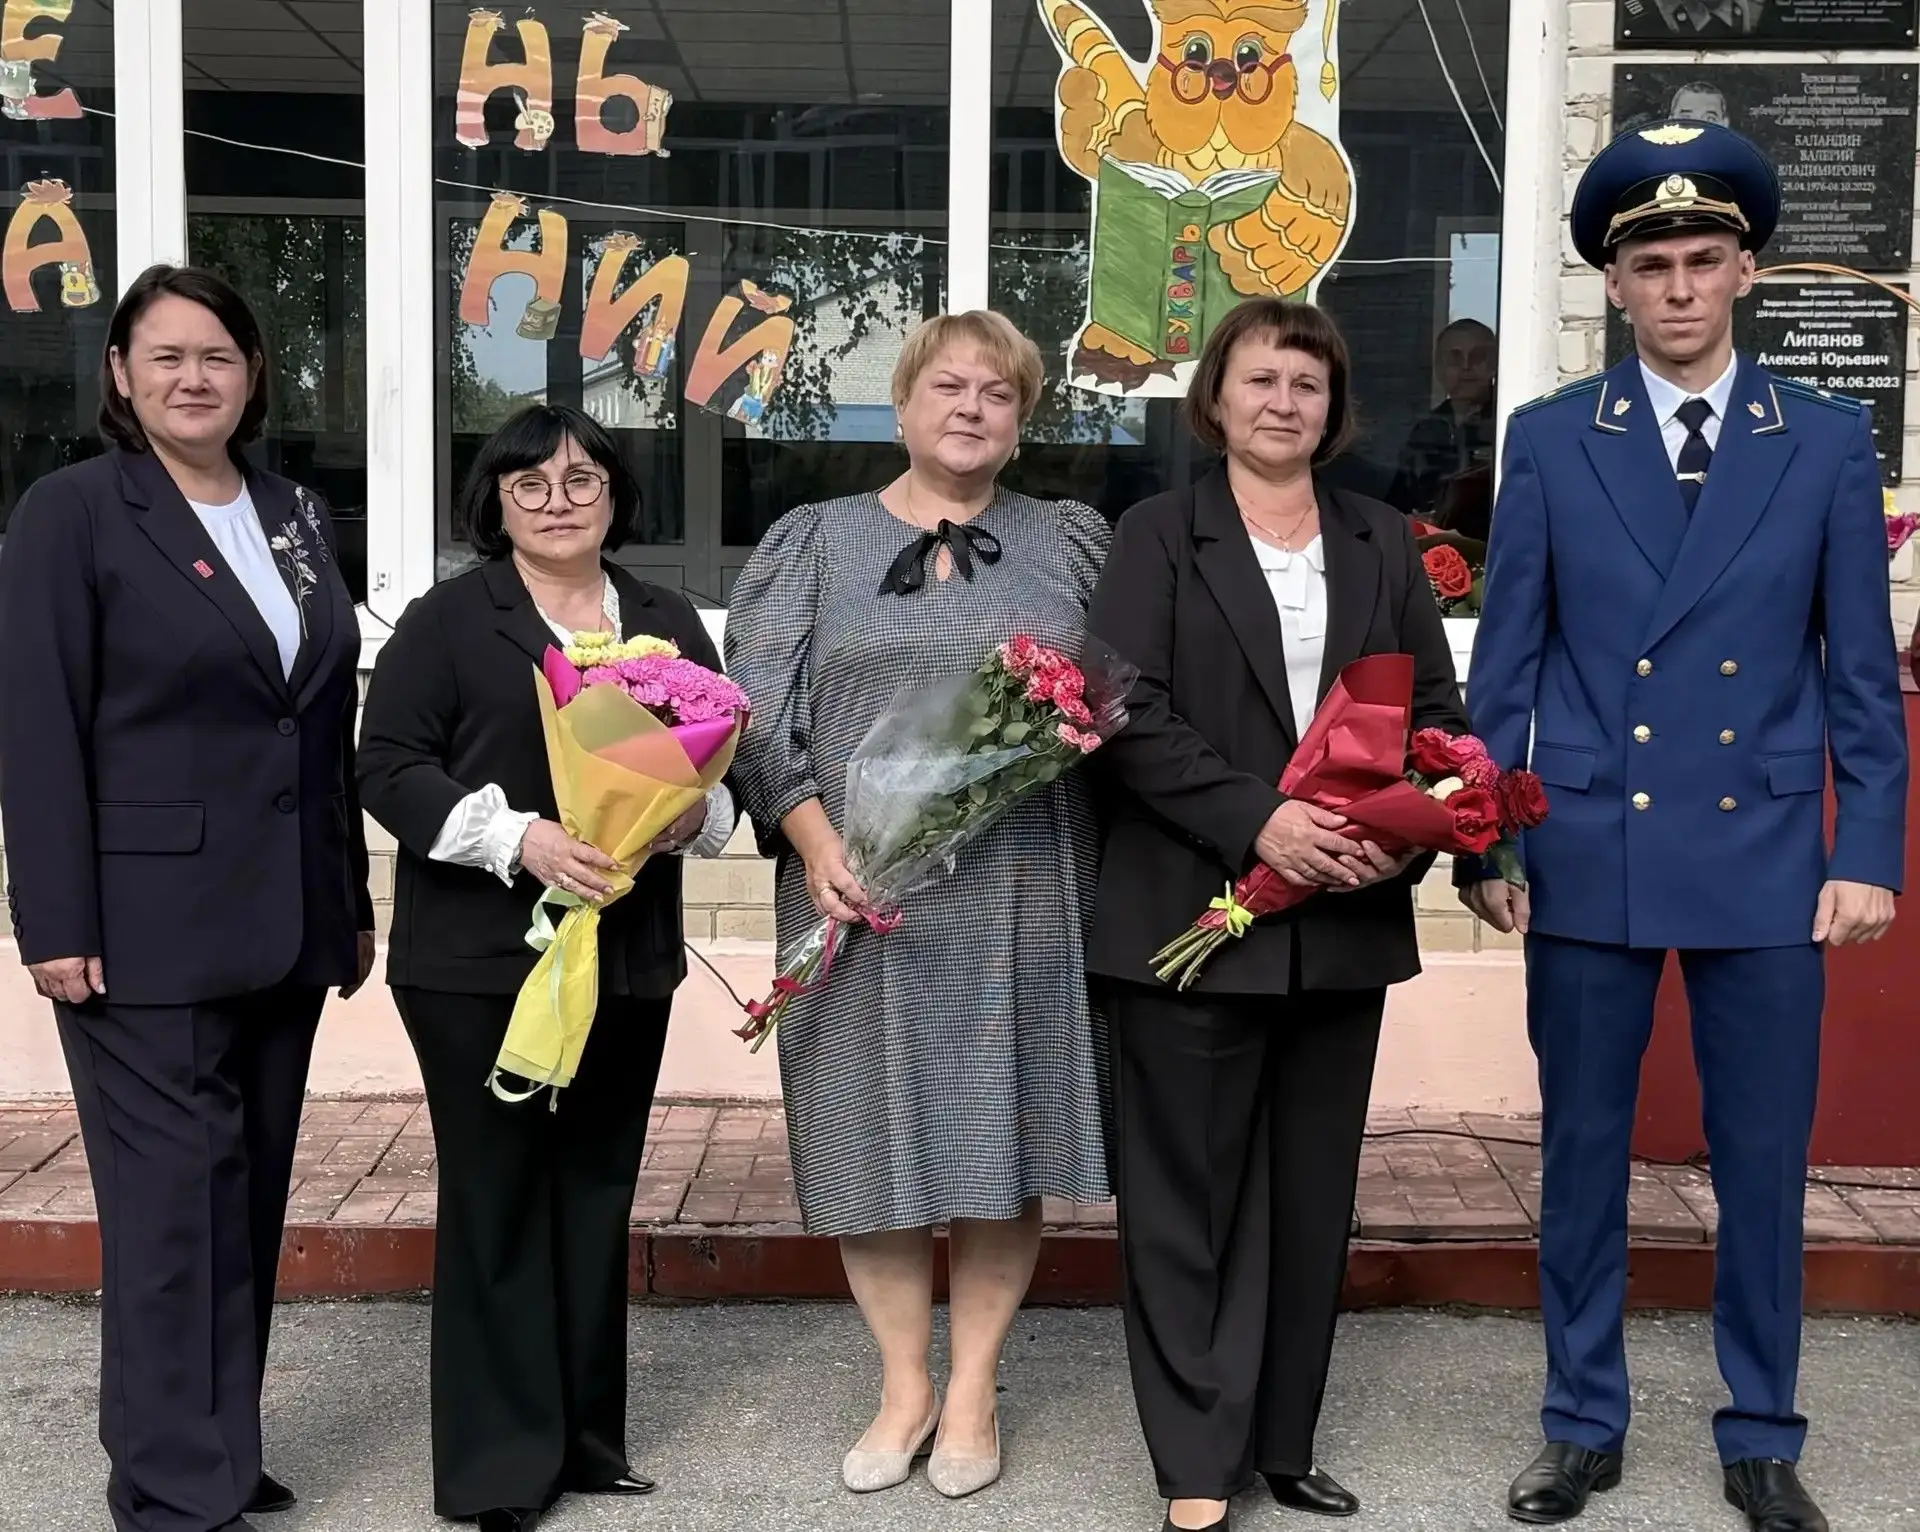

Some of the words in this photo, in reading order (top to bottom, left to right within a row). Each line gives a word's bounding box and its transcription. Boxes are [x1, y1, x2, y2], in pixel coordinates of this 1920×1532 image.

[1800, 148, 1856, 161] ВАЛЕРИЙ
[1777, 164, 1876, 177] ВЛАДИМИРОВИЧ
[1166, 224, 1201, 354] БУКВАРЬ
[1783, 330, 1864, 347] Липанов
[1757, 352, 1818, 365] Алексей
[1822, 352, 1889, 368] Юрьевич
[1827, 376, 1900, 388] 06.06.2023
